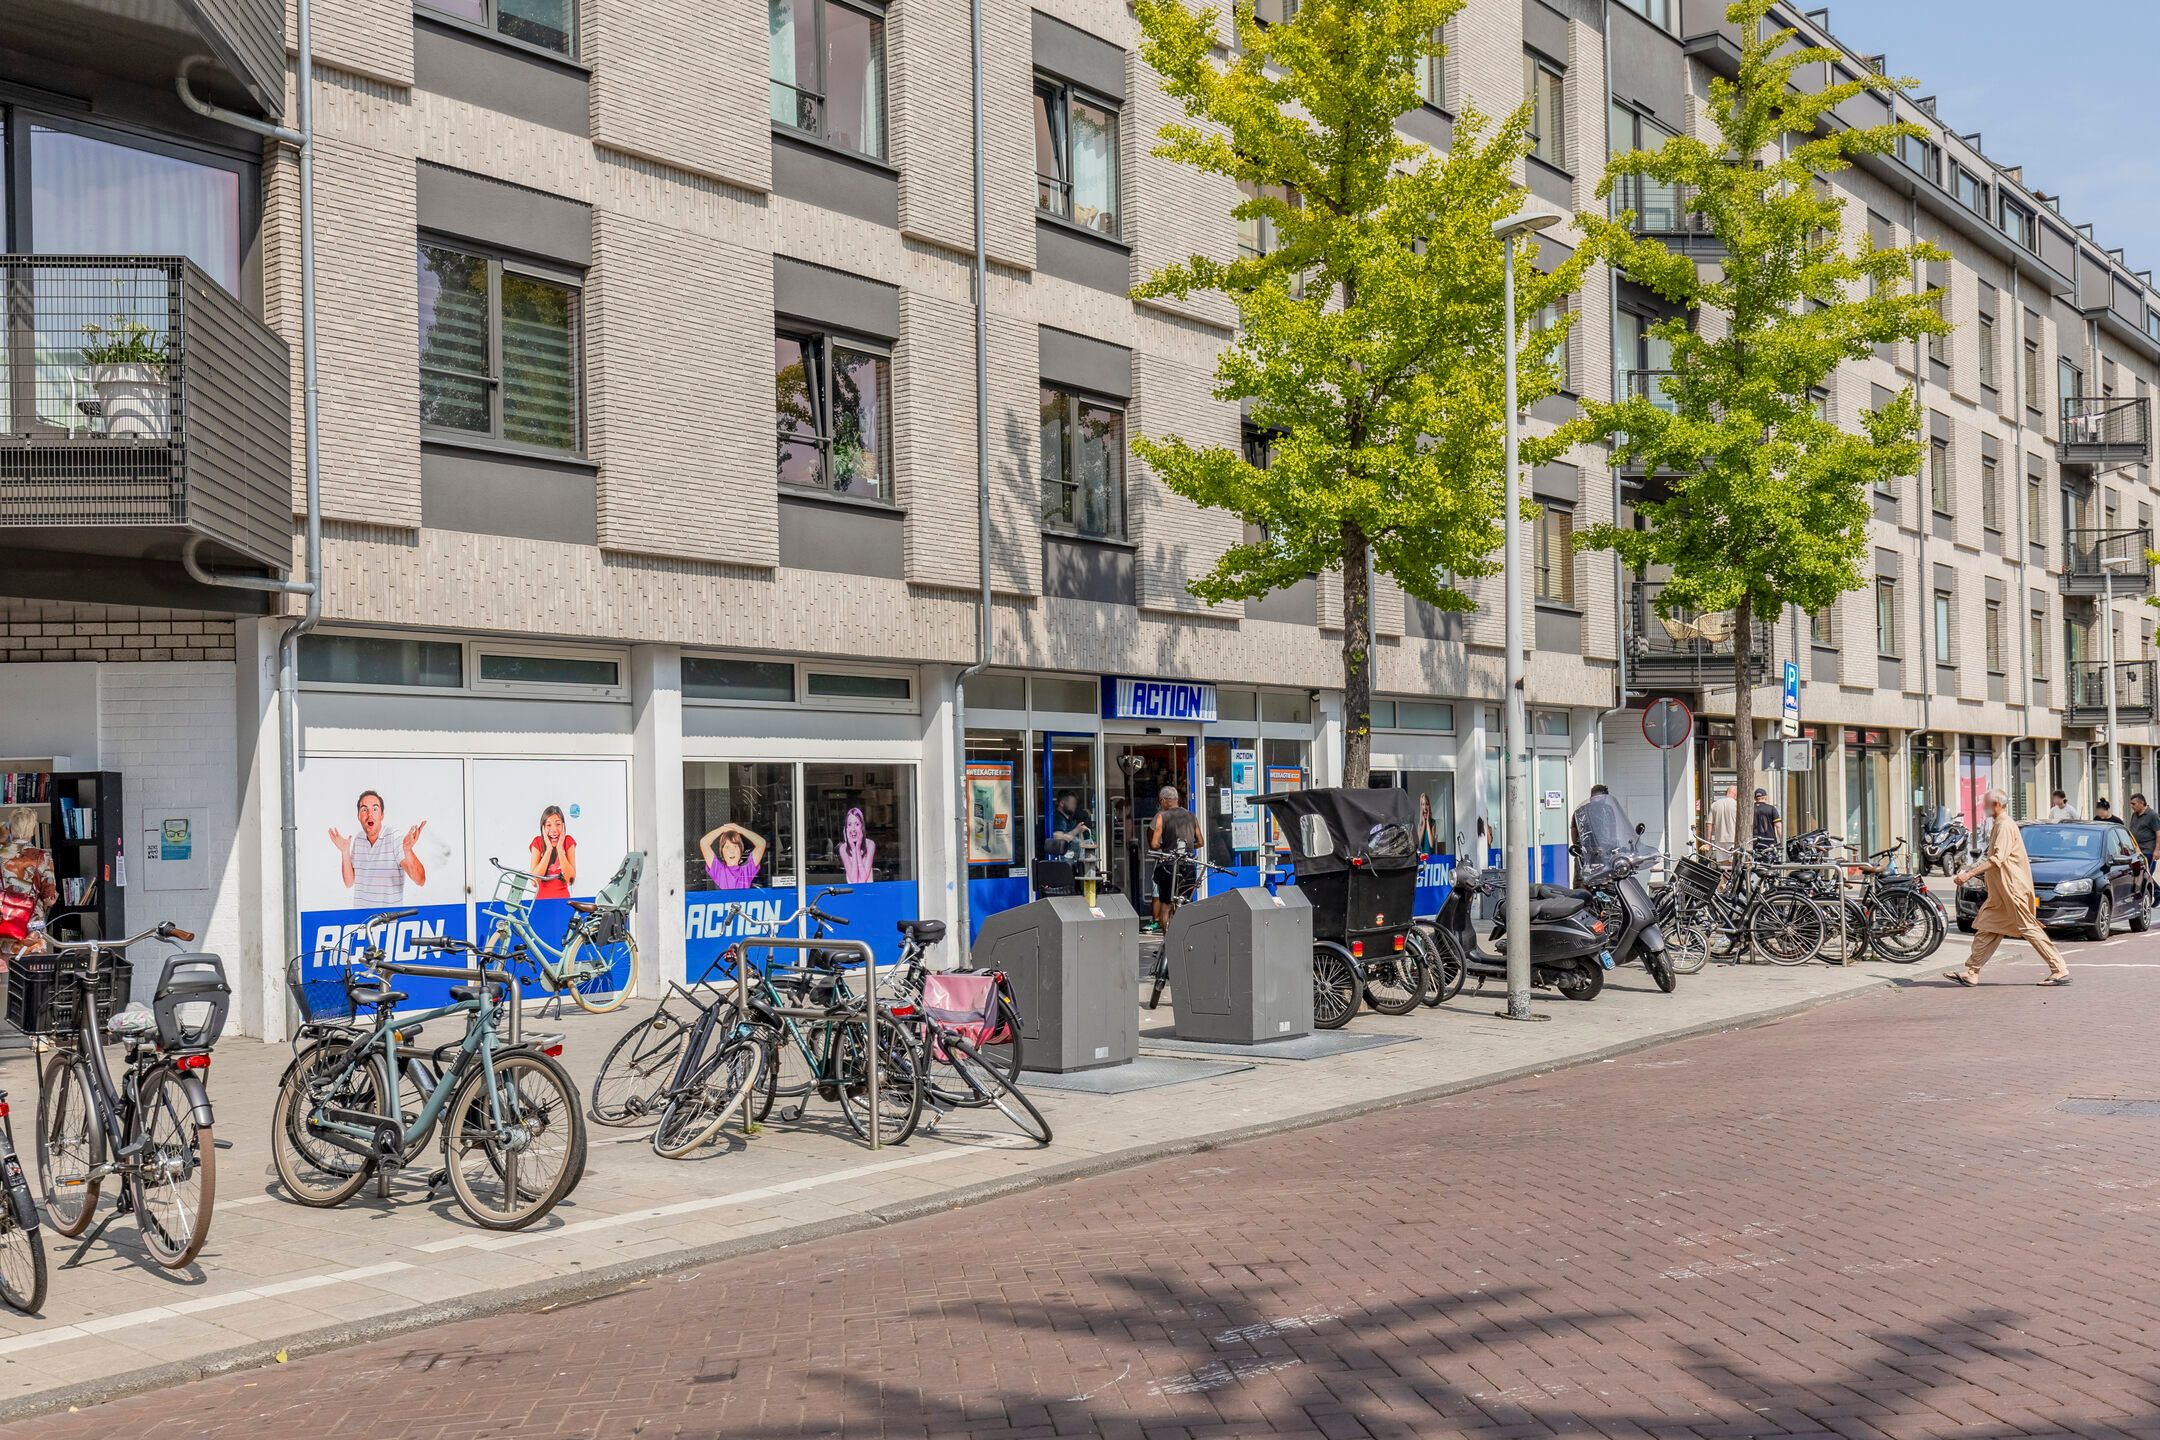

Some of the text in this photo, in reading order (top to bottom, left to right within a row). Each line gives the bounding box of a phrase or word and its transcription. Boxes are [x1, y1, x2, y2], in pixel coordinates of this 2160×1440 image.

[1788, 667, 1796, 690] P
[1132, 683, 1202, 718] ACTION
[686, 899, 781, 940] ACTION
